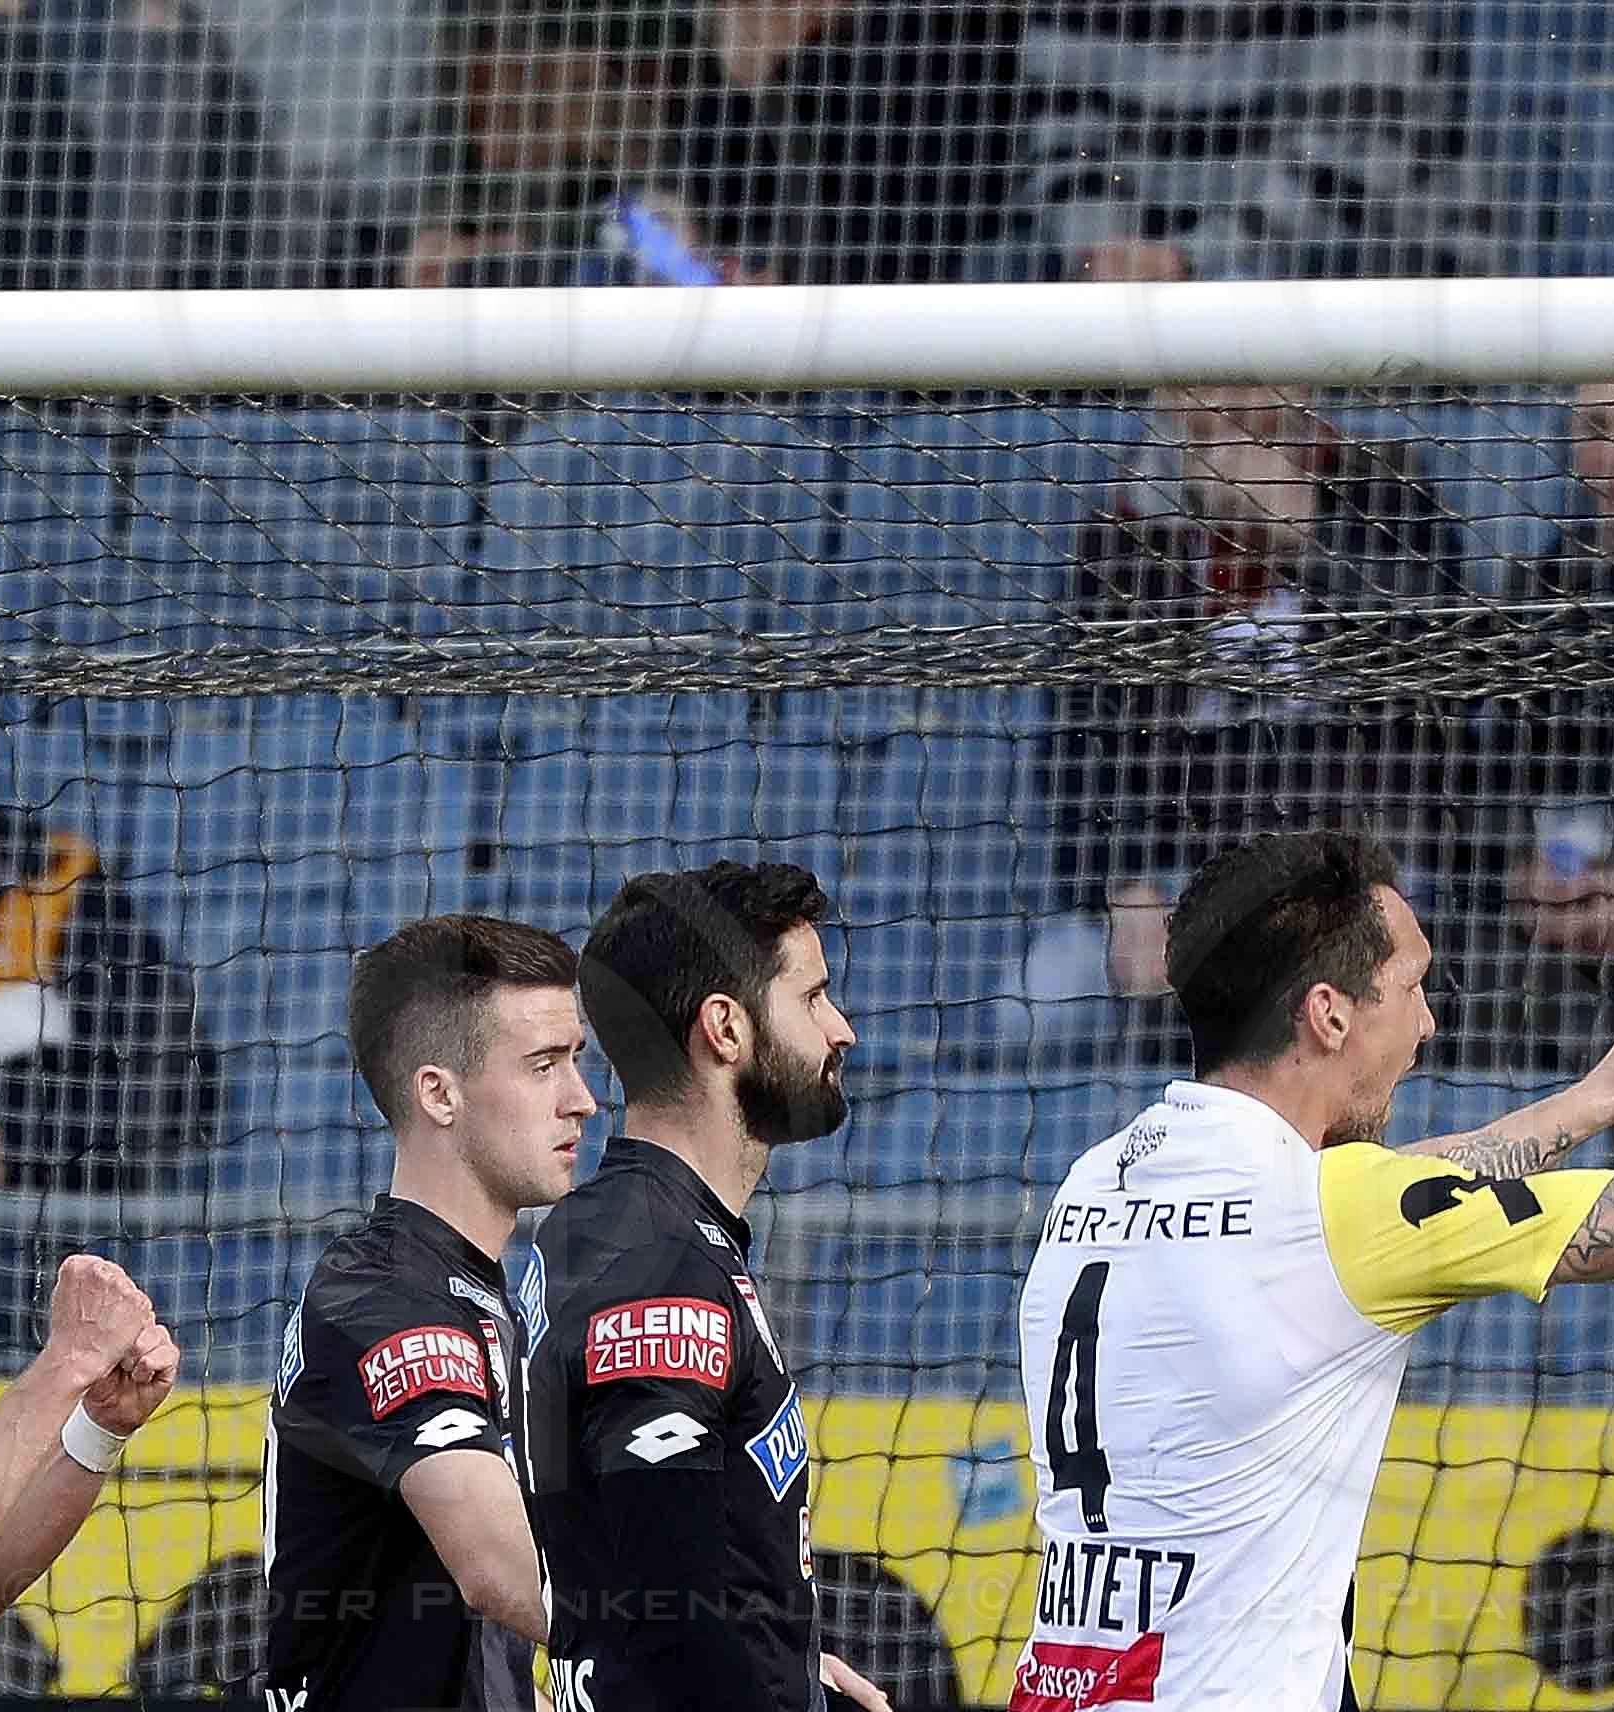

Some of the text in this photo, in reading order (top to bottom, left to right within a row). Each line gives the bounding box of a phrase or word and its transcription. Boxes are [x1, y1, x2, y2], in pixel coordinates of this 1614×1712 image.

[595, 1305, 728, 1344] KLEINE
[364, 1332, 481, 1387] KLEINE
[372, 1357, 486, 1413] ZEITUNG
[595, 1337, 727, 1378] ZEITUNG
[1045, 1260, 1111, 1532] 4
